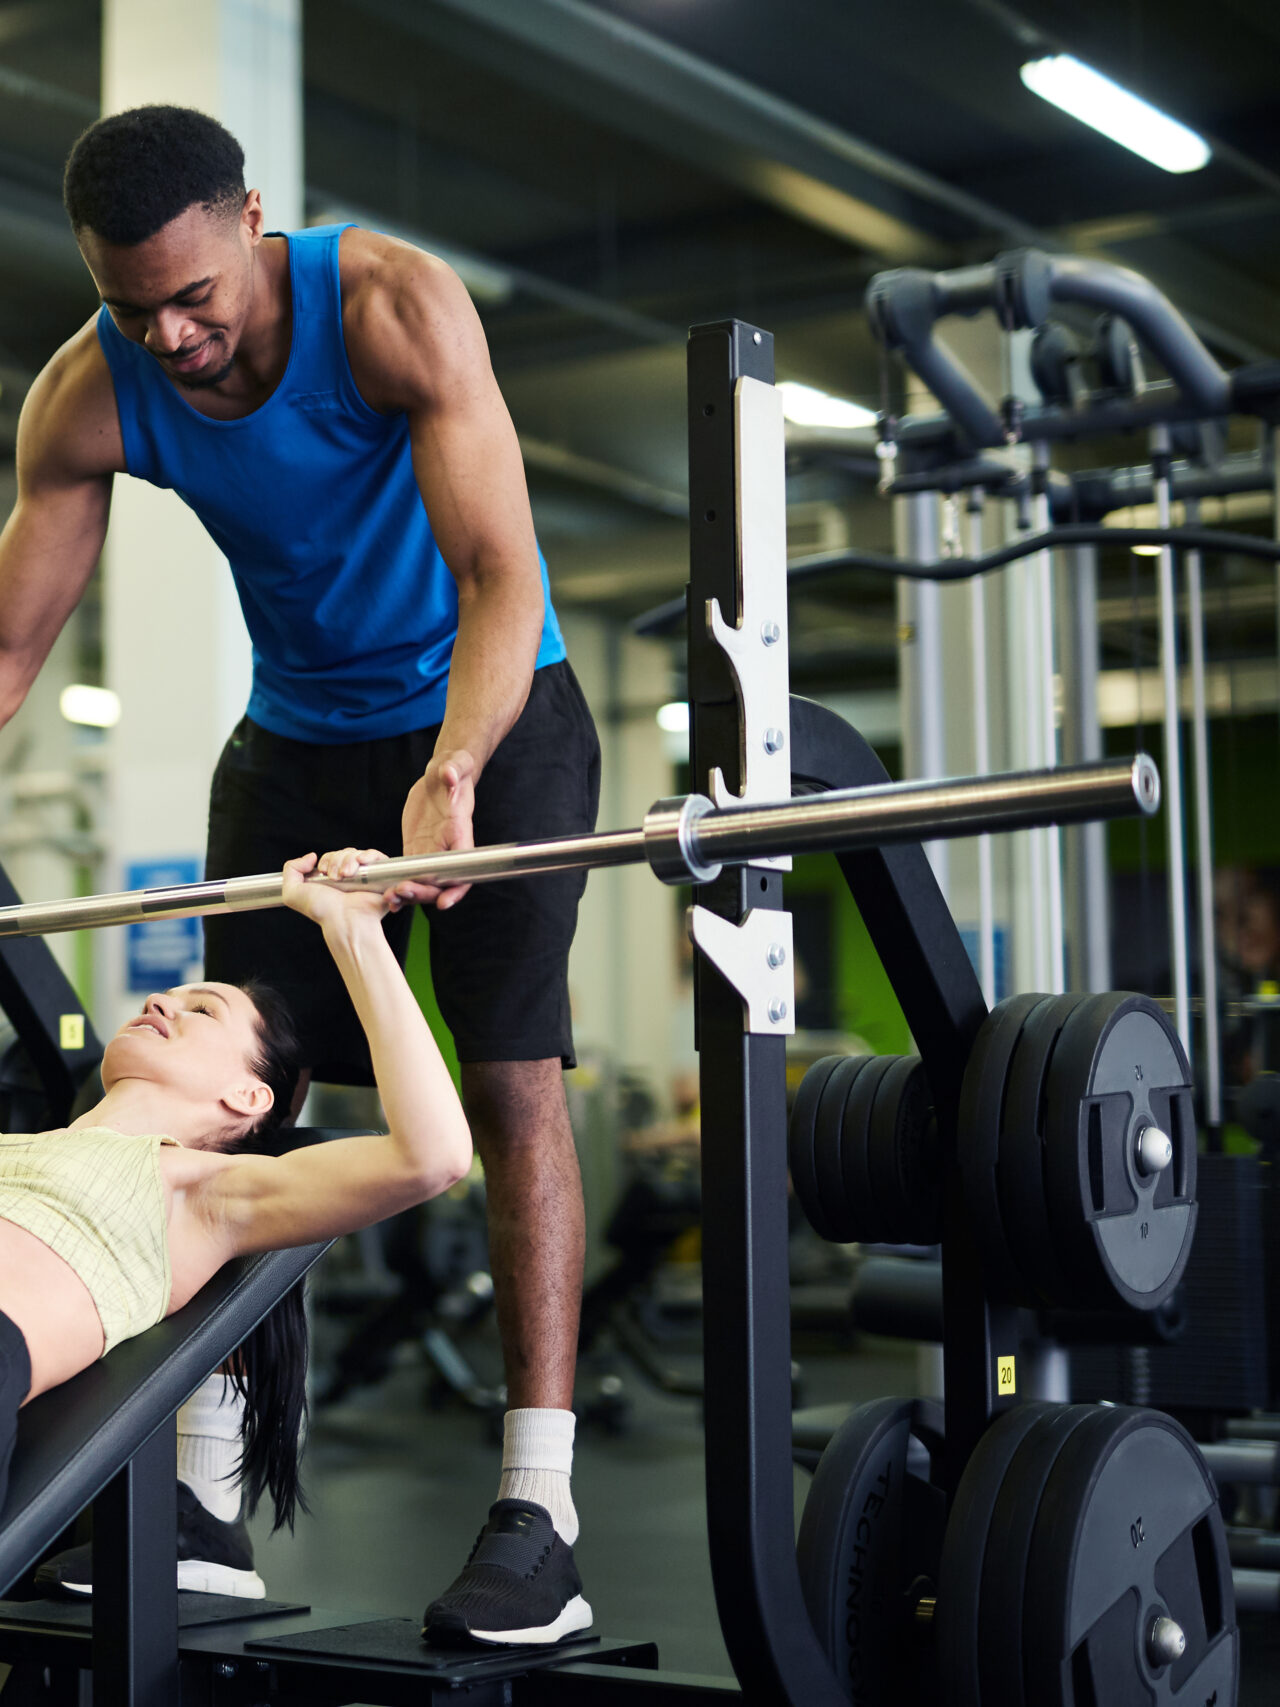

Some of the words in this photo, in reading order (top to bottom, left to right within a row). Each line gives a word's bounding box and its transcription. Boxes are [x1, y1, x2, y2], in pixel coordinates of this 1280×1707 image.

[1140, 1221, 1149, 1240] 10
[1001, 1366, 1012, 1384] 20
[1130, 1515, 1145, 1549] 20
[845, 1460, 892, 1707] TECHNOGY
